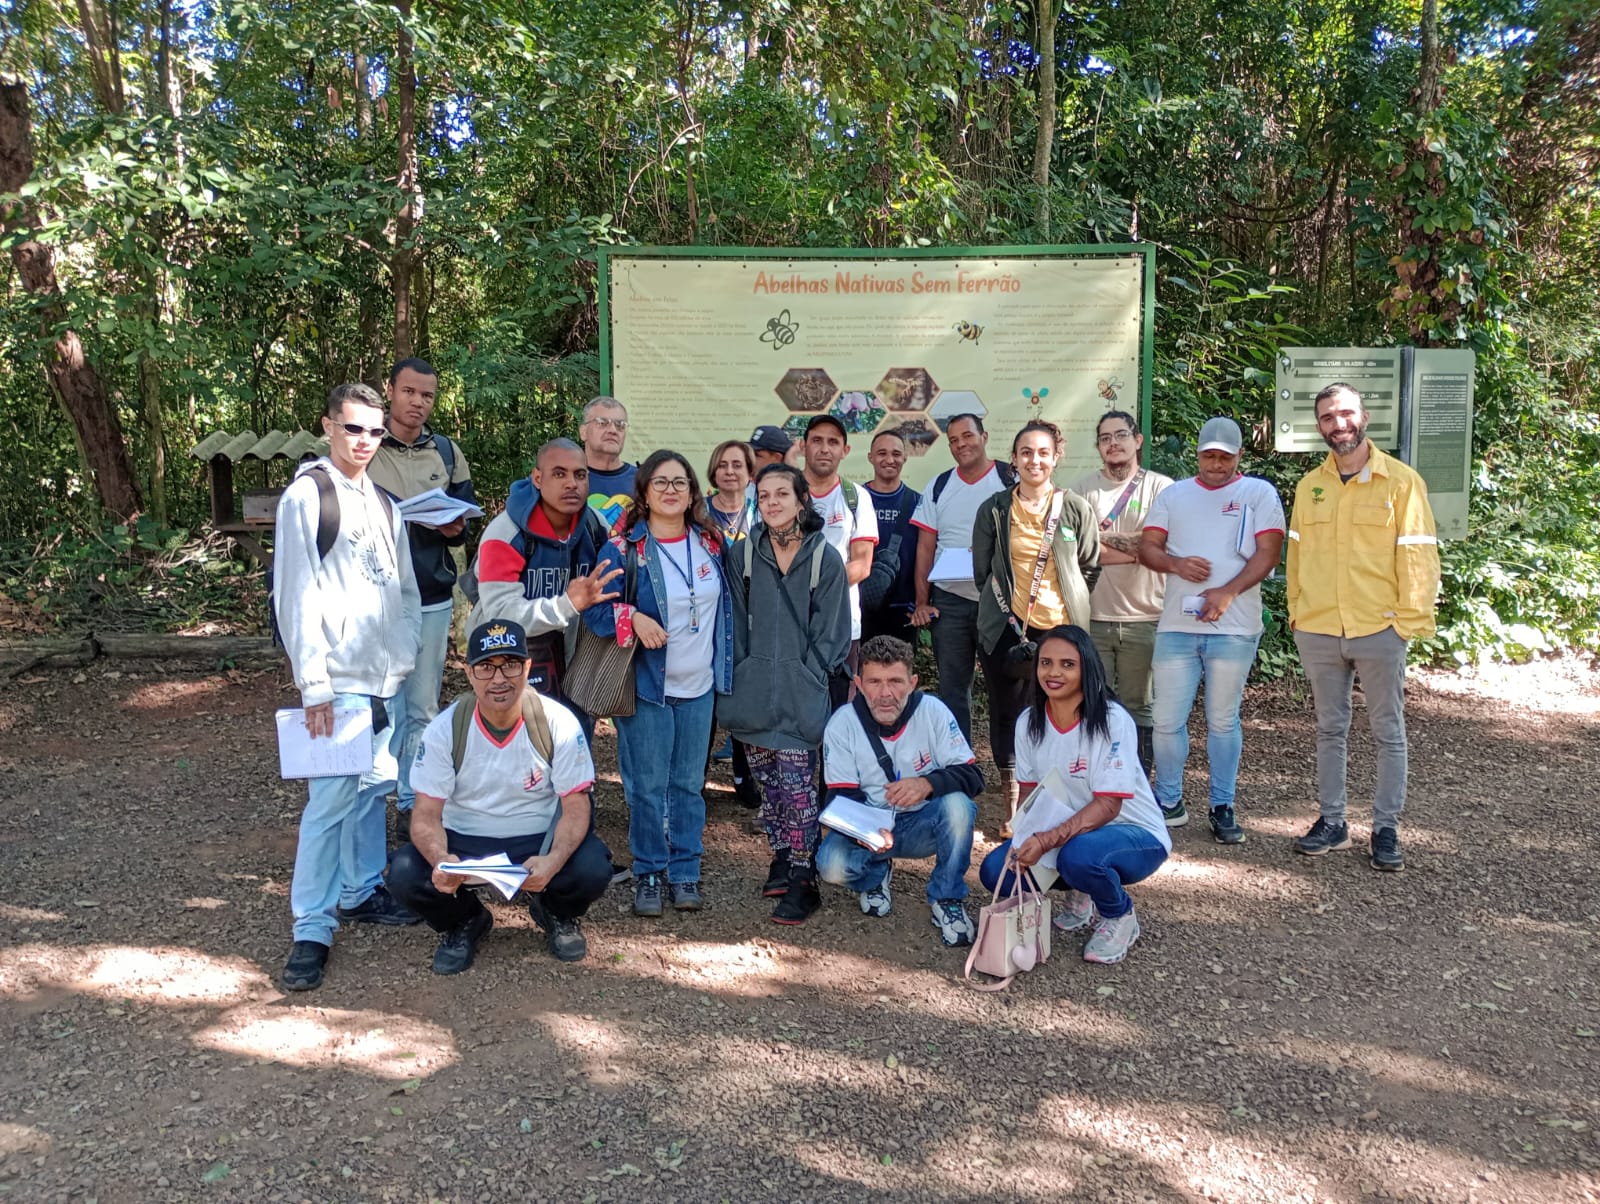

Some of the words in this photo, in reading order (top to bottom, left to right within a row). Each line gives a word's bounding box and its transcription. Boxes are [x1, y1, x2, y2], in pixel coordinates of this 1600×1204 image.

[753, 271, 829, 294] Abelhas
[835, 271, 905, 294] Nativas
[911, 271, 950, 294] Sem
[957, 271, 1021, 294] Ferrão
[876, 509, 901, 521] CEP
[480, 634, 517, 651] JESUS
